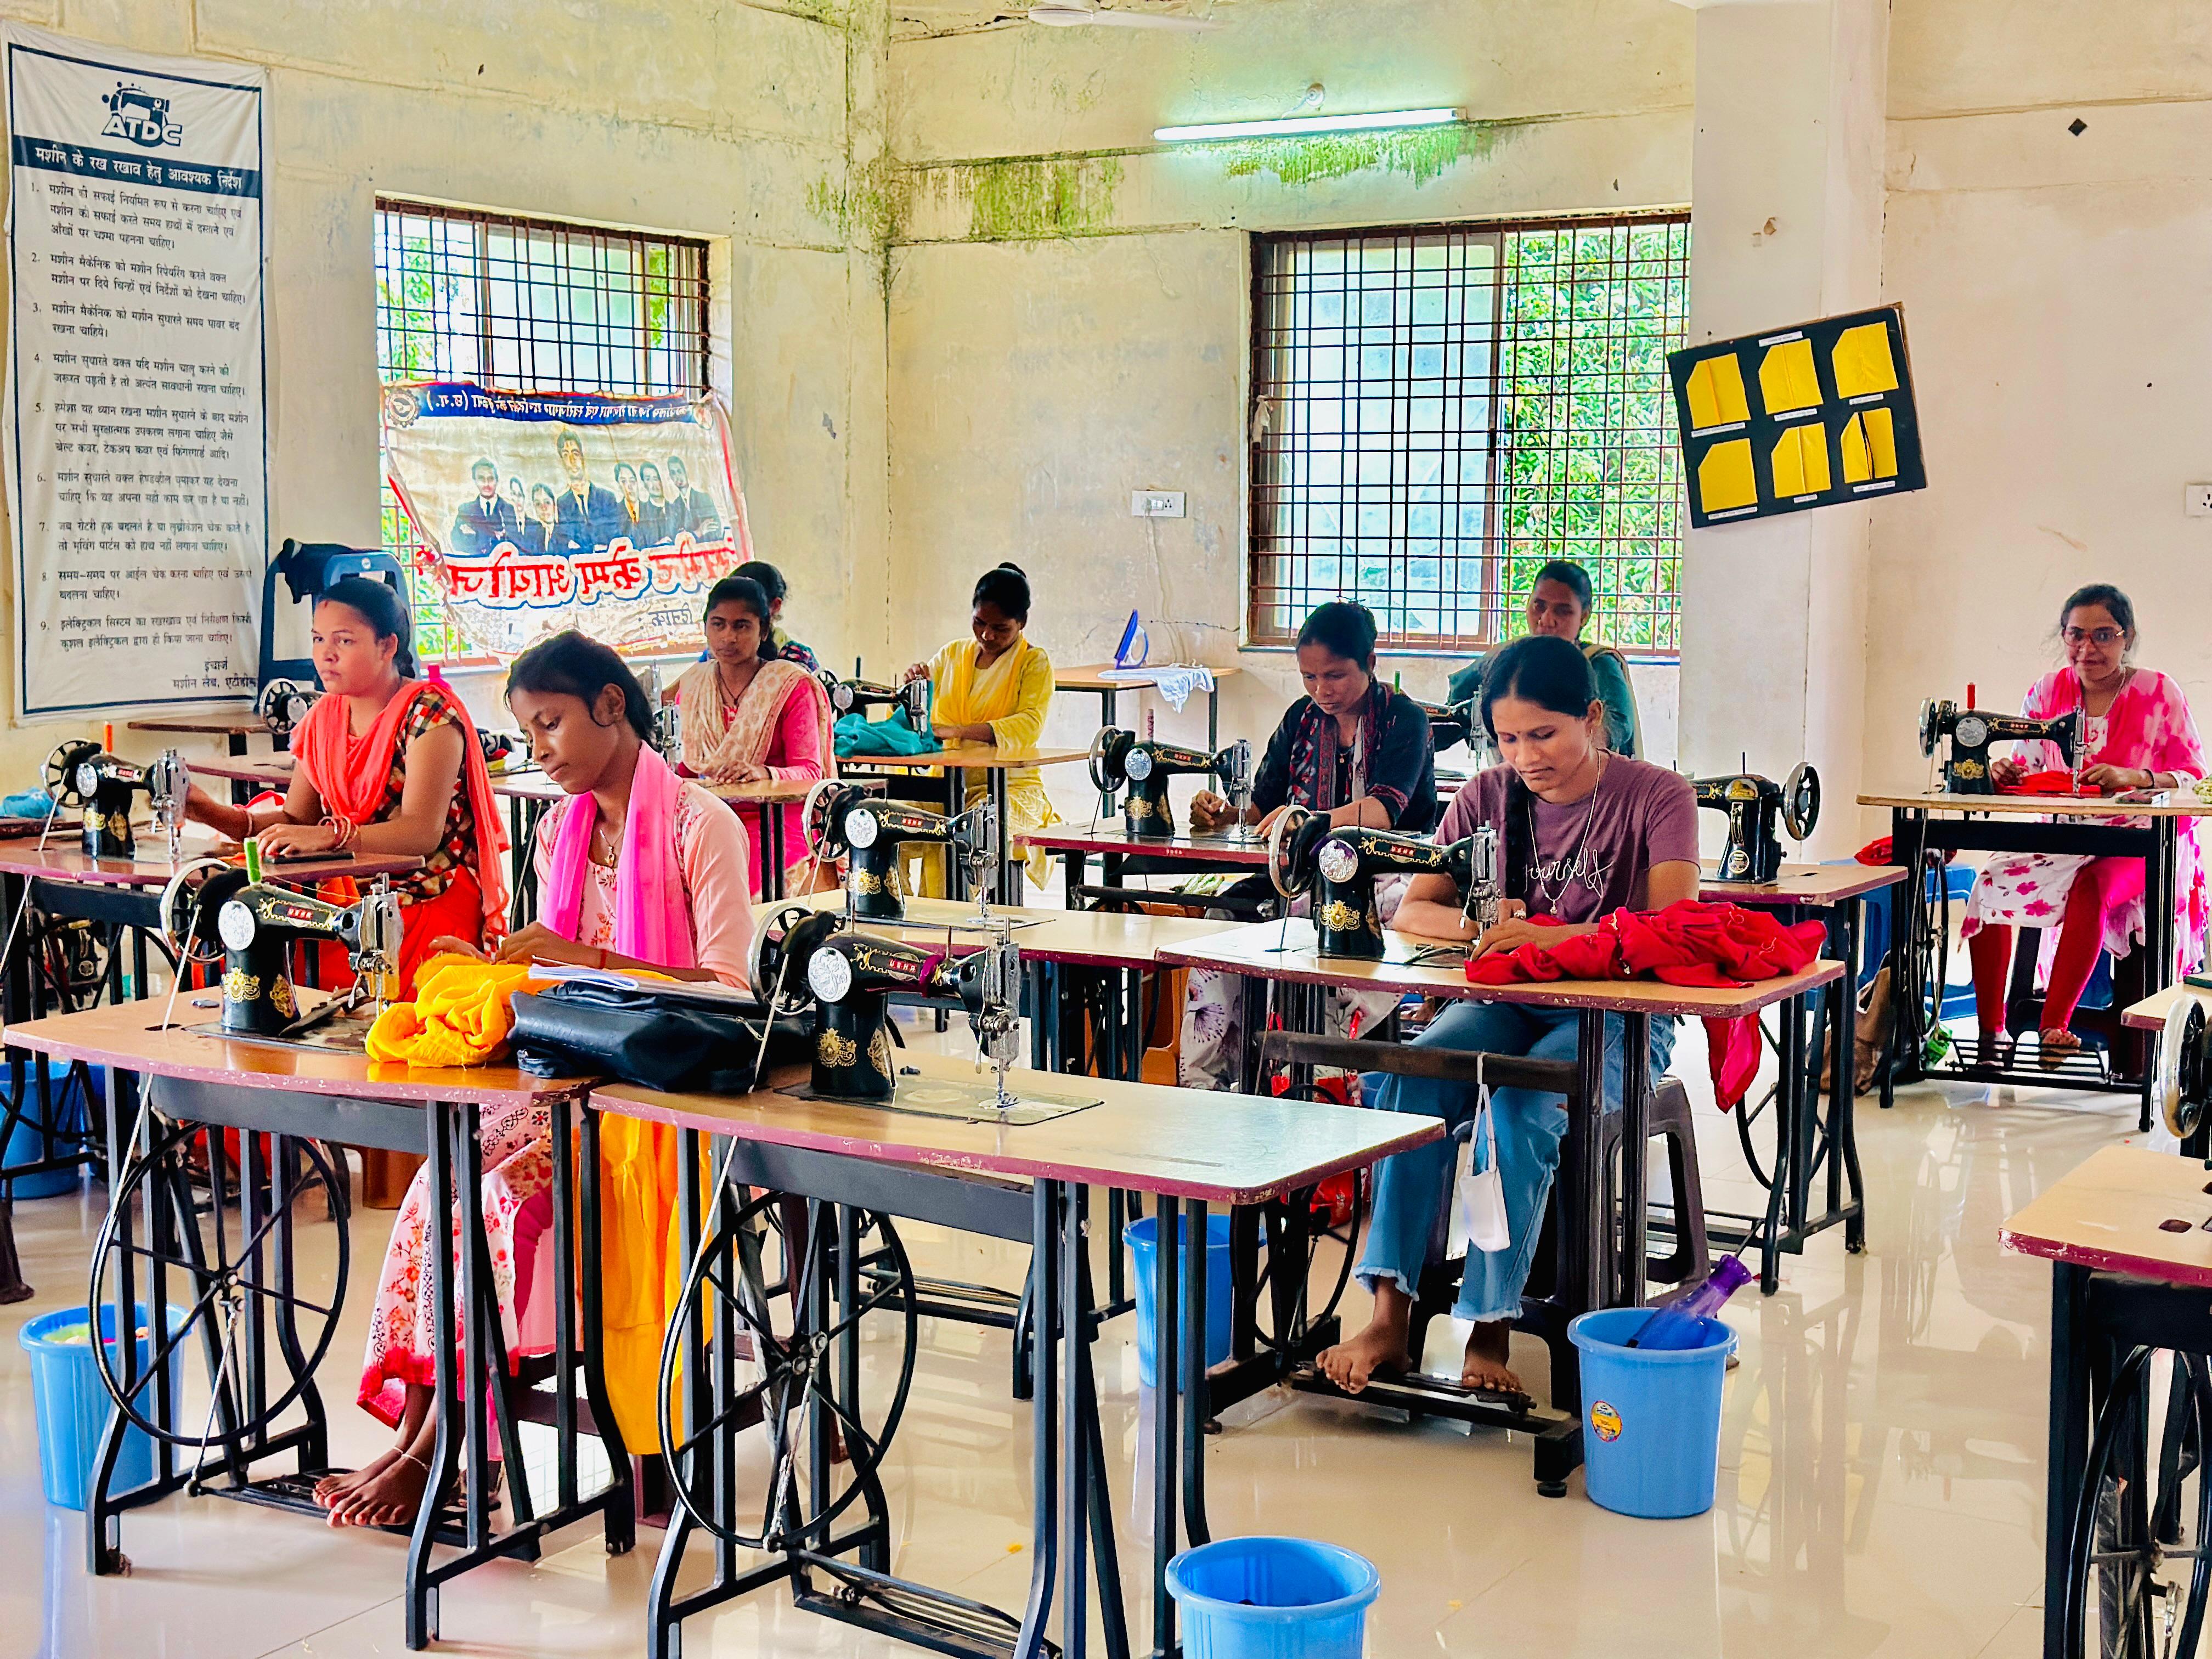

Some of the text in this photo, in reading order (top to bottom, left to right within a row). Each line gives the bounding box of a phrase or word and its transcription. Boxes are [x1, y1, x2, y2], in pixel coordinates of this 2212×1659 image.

[101, 115, 183, 147] ATDC
[35, 144, 67, 165] मशीन
[72, 150, 84, 167] के
[90, 156, 108, 172] रख
[112, 160, 141, 176] रखाव
[147, 161, 162, 184] हेतु
[168, 167, 212, 185] आवश्यक
[49, 182, 74, 196] मशीन
[93, 189, 115, 205] सफाई
[120, 191, 149, 207] नियमित
[182, 203, 202, 213] करना
[50, 202, 73, 216] मशीन
[93, 209, 115, 223] सफाई
[143, 217, 161, 228] समय
[78, 228, 89, 238] पर
[119, 233, 144, 245] पहनना
[32, 253, 40, 262] 2.
[50, 251, 74, 266] मशीन
[115, 259, 126, 271] को
[131, 261, 151, 274] मशीन
[189, 268, 205, 280] करते
[51, 271, 75, 285] मशीन
[80, 277, 90, 286] पर
[95, 275, 108, 289] दिये
[139, 281, 151, 295] एवं
[197, 286, 217, 300] देखना
[52, 301, 75, 314] मशीन
[116, 307, 126, 319] को
[132, 308, 153, 322] मशीन
[186, 317, 204, 327] समय
[53, 324, 75, 334] रखना
[53, 350, 77, 364] मशीन
[136, 357, 149, 370] यदि
[154, 358, 174, 371] मशीन
[120, 375, 129, 387] तो
[196, 383, 216, 393] रखना
[121, 407, 141, 416] रखना
[146, 405, 167, 418] मशीन
[229, 411, 248, 423] मशीन
[56, 424, 66, 432] पर
[168, 428, 190, 438] लगाना
[57, 469, 79, 482] मशीन
[119, 494, 140, 503] अपना
[110, 571, 120, 579] पर
[173, 675, 197, 689] मशीन
